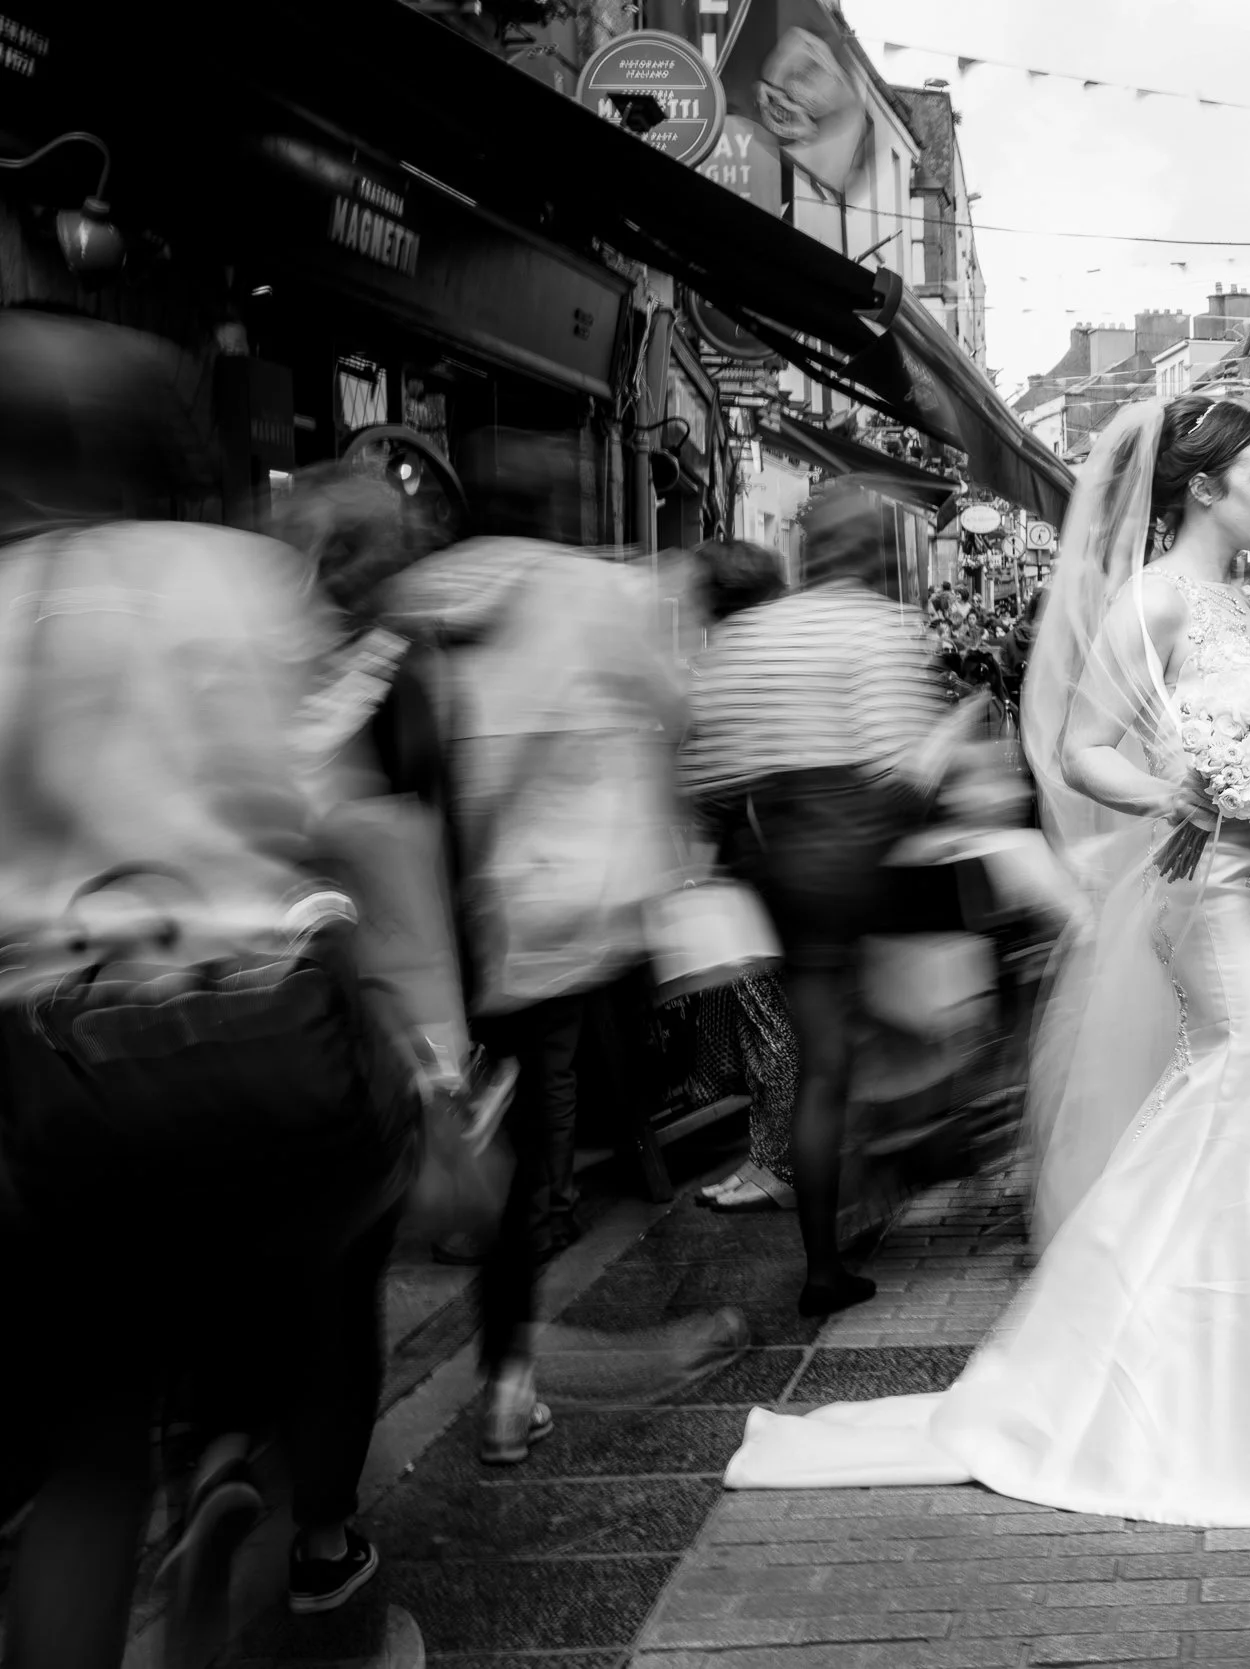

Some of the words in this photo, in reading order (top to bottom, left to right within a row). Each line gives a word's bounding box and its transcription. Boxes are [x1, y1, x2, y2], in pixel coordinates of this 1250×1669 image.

[619, 59, 676, 69] RISTORANTE
[626, 70, 670, 79] ITALIANO
[329, 194, 421, 278] MAGNETTI
